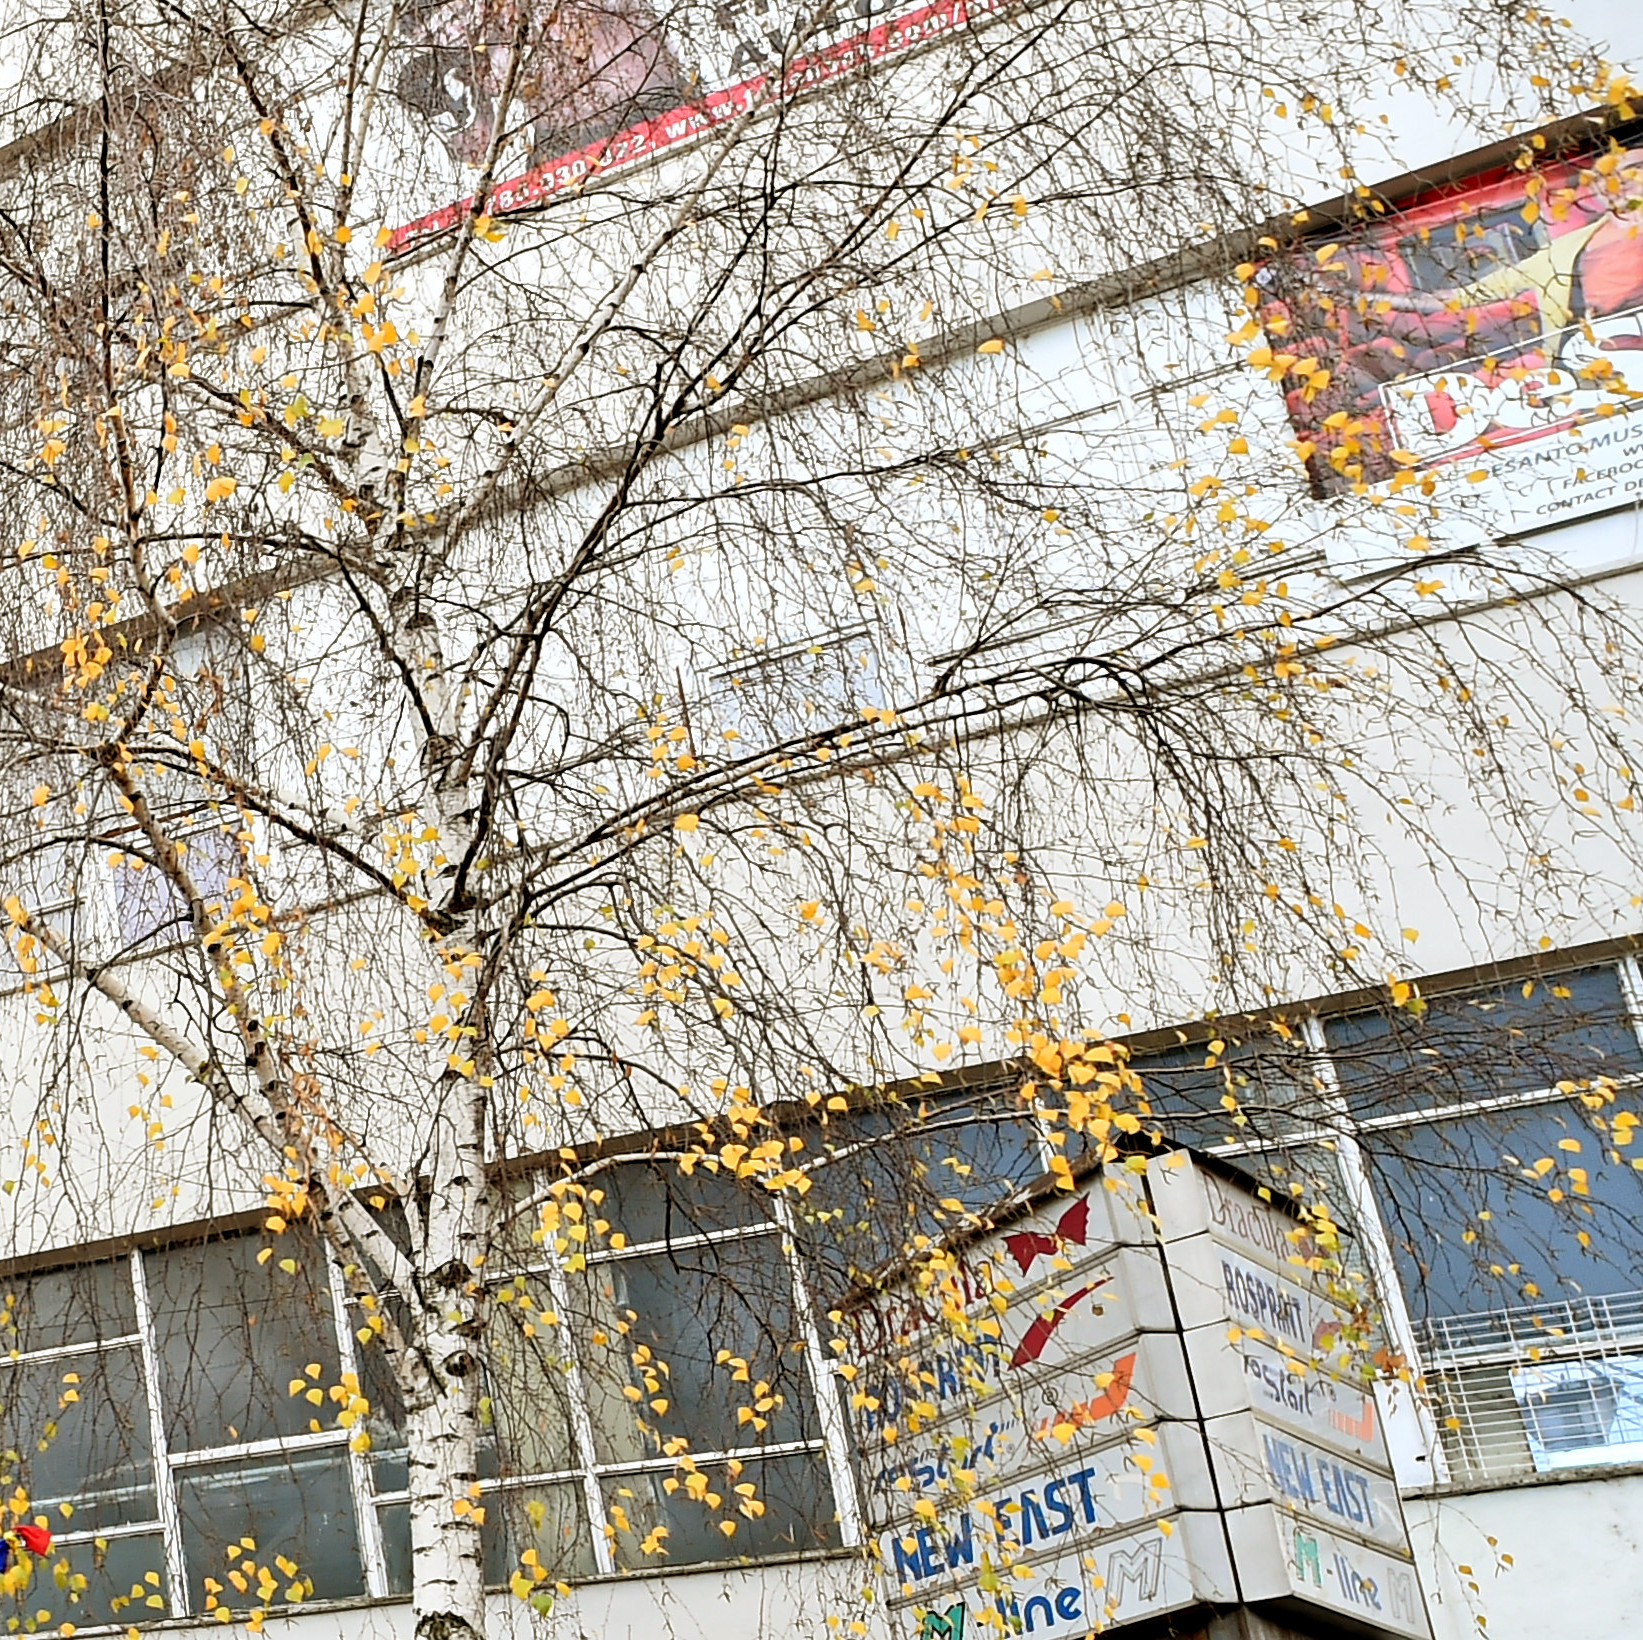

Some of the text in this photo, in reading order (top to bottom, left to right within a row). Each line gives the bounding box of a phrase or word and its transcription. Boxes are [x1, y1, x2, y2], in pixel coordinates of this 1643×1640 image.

[890, 1466, 1097, 1584] NEW EAST
[1262, 1433, 1375, 1529] NEW EAST
